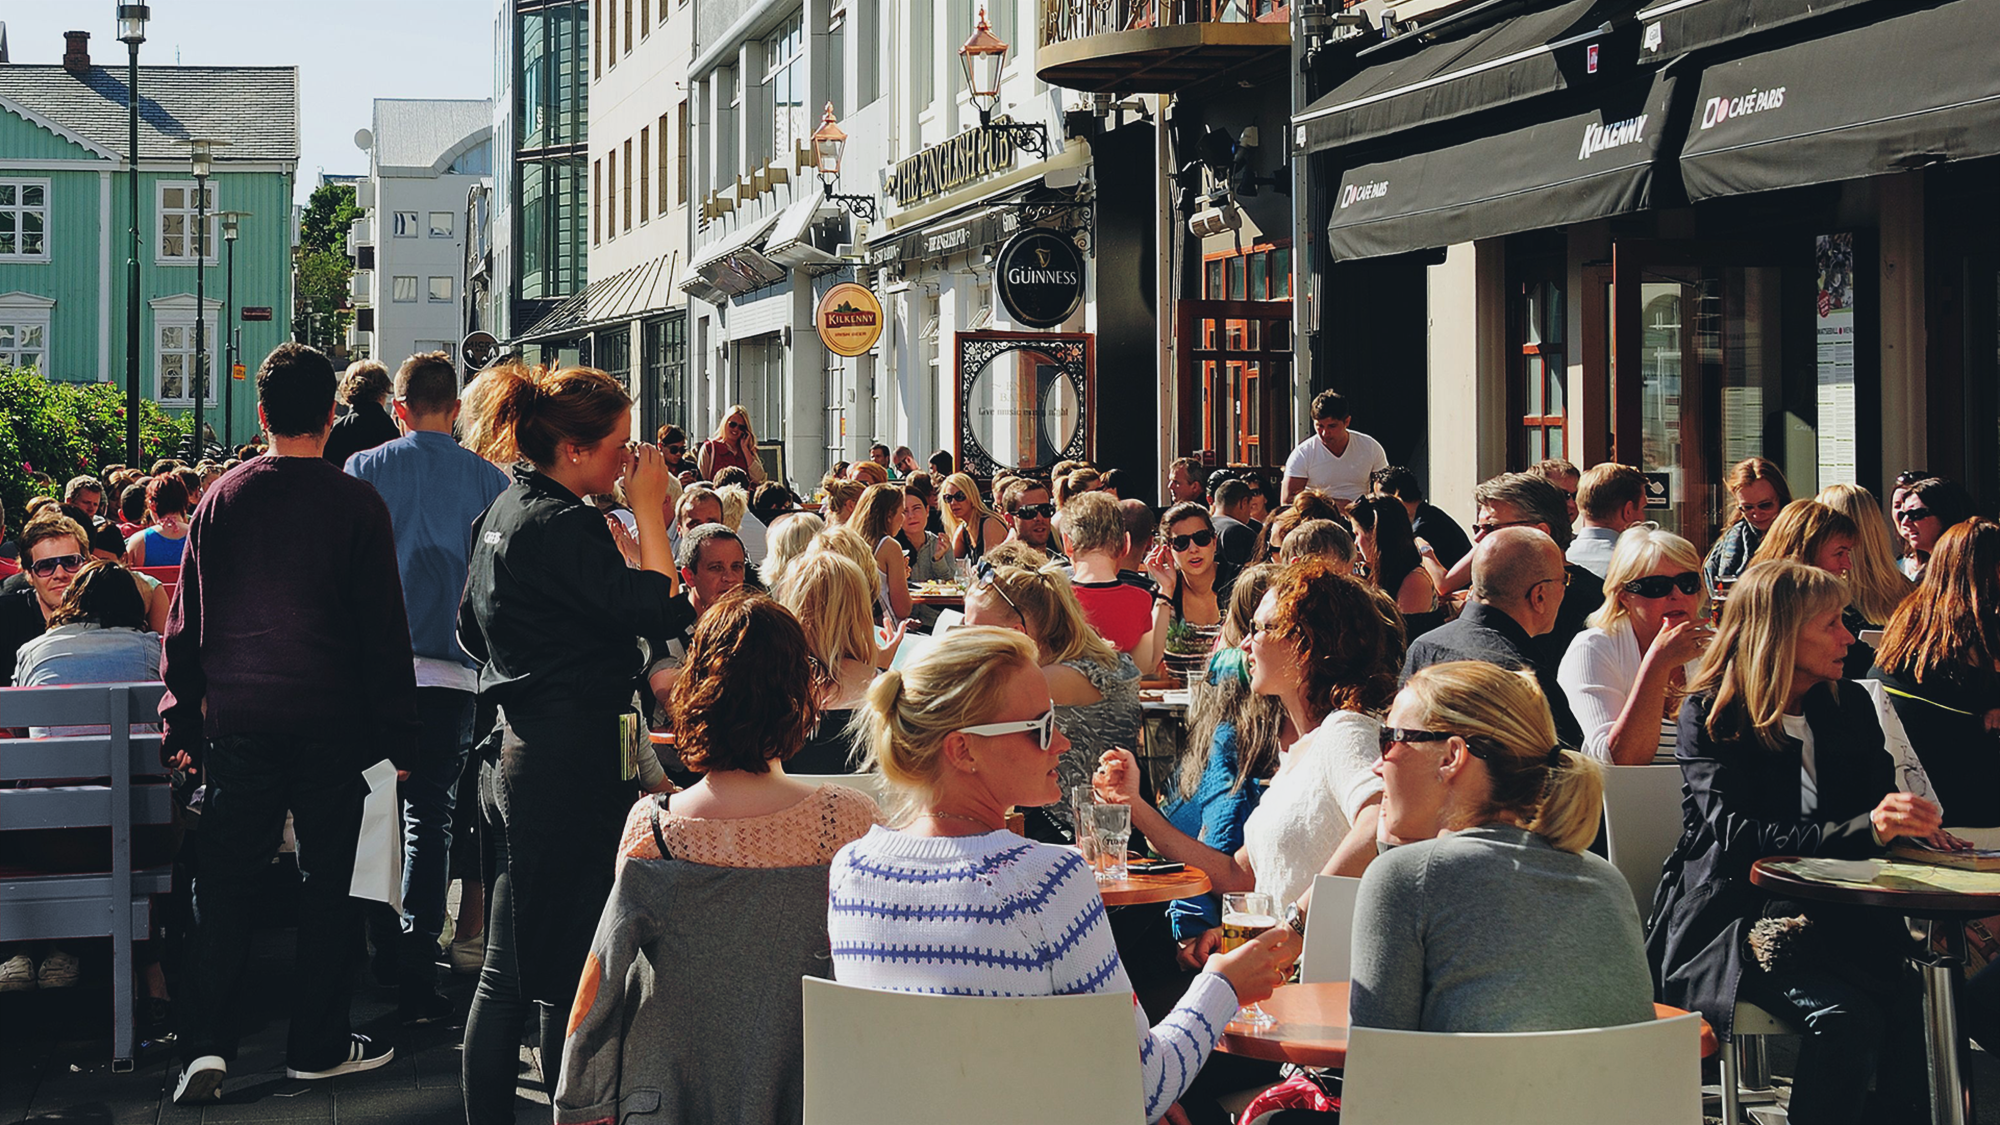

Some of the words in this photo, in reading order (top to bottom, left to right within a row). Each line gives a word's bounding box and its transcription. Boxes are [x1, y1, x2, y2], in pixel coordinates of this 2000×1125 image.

[1728, 88, 1757, 118] CAFÉ
[1754, 87, 1786, 112] PARIS
[1578, 114, 1648, 160] KILKENNY
[896, 155, 921, 207] THE
[921, 127, 980, 198] ENGLISH
[979, 115, 1012, 175] PUB
[828, 314, 874, 325] KILKENNY
